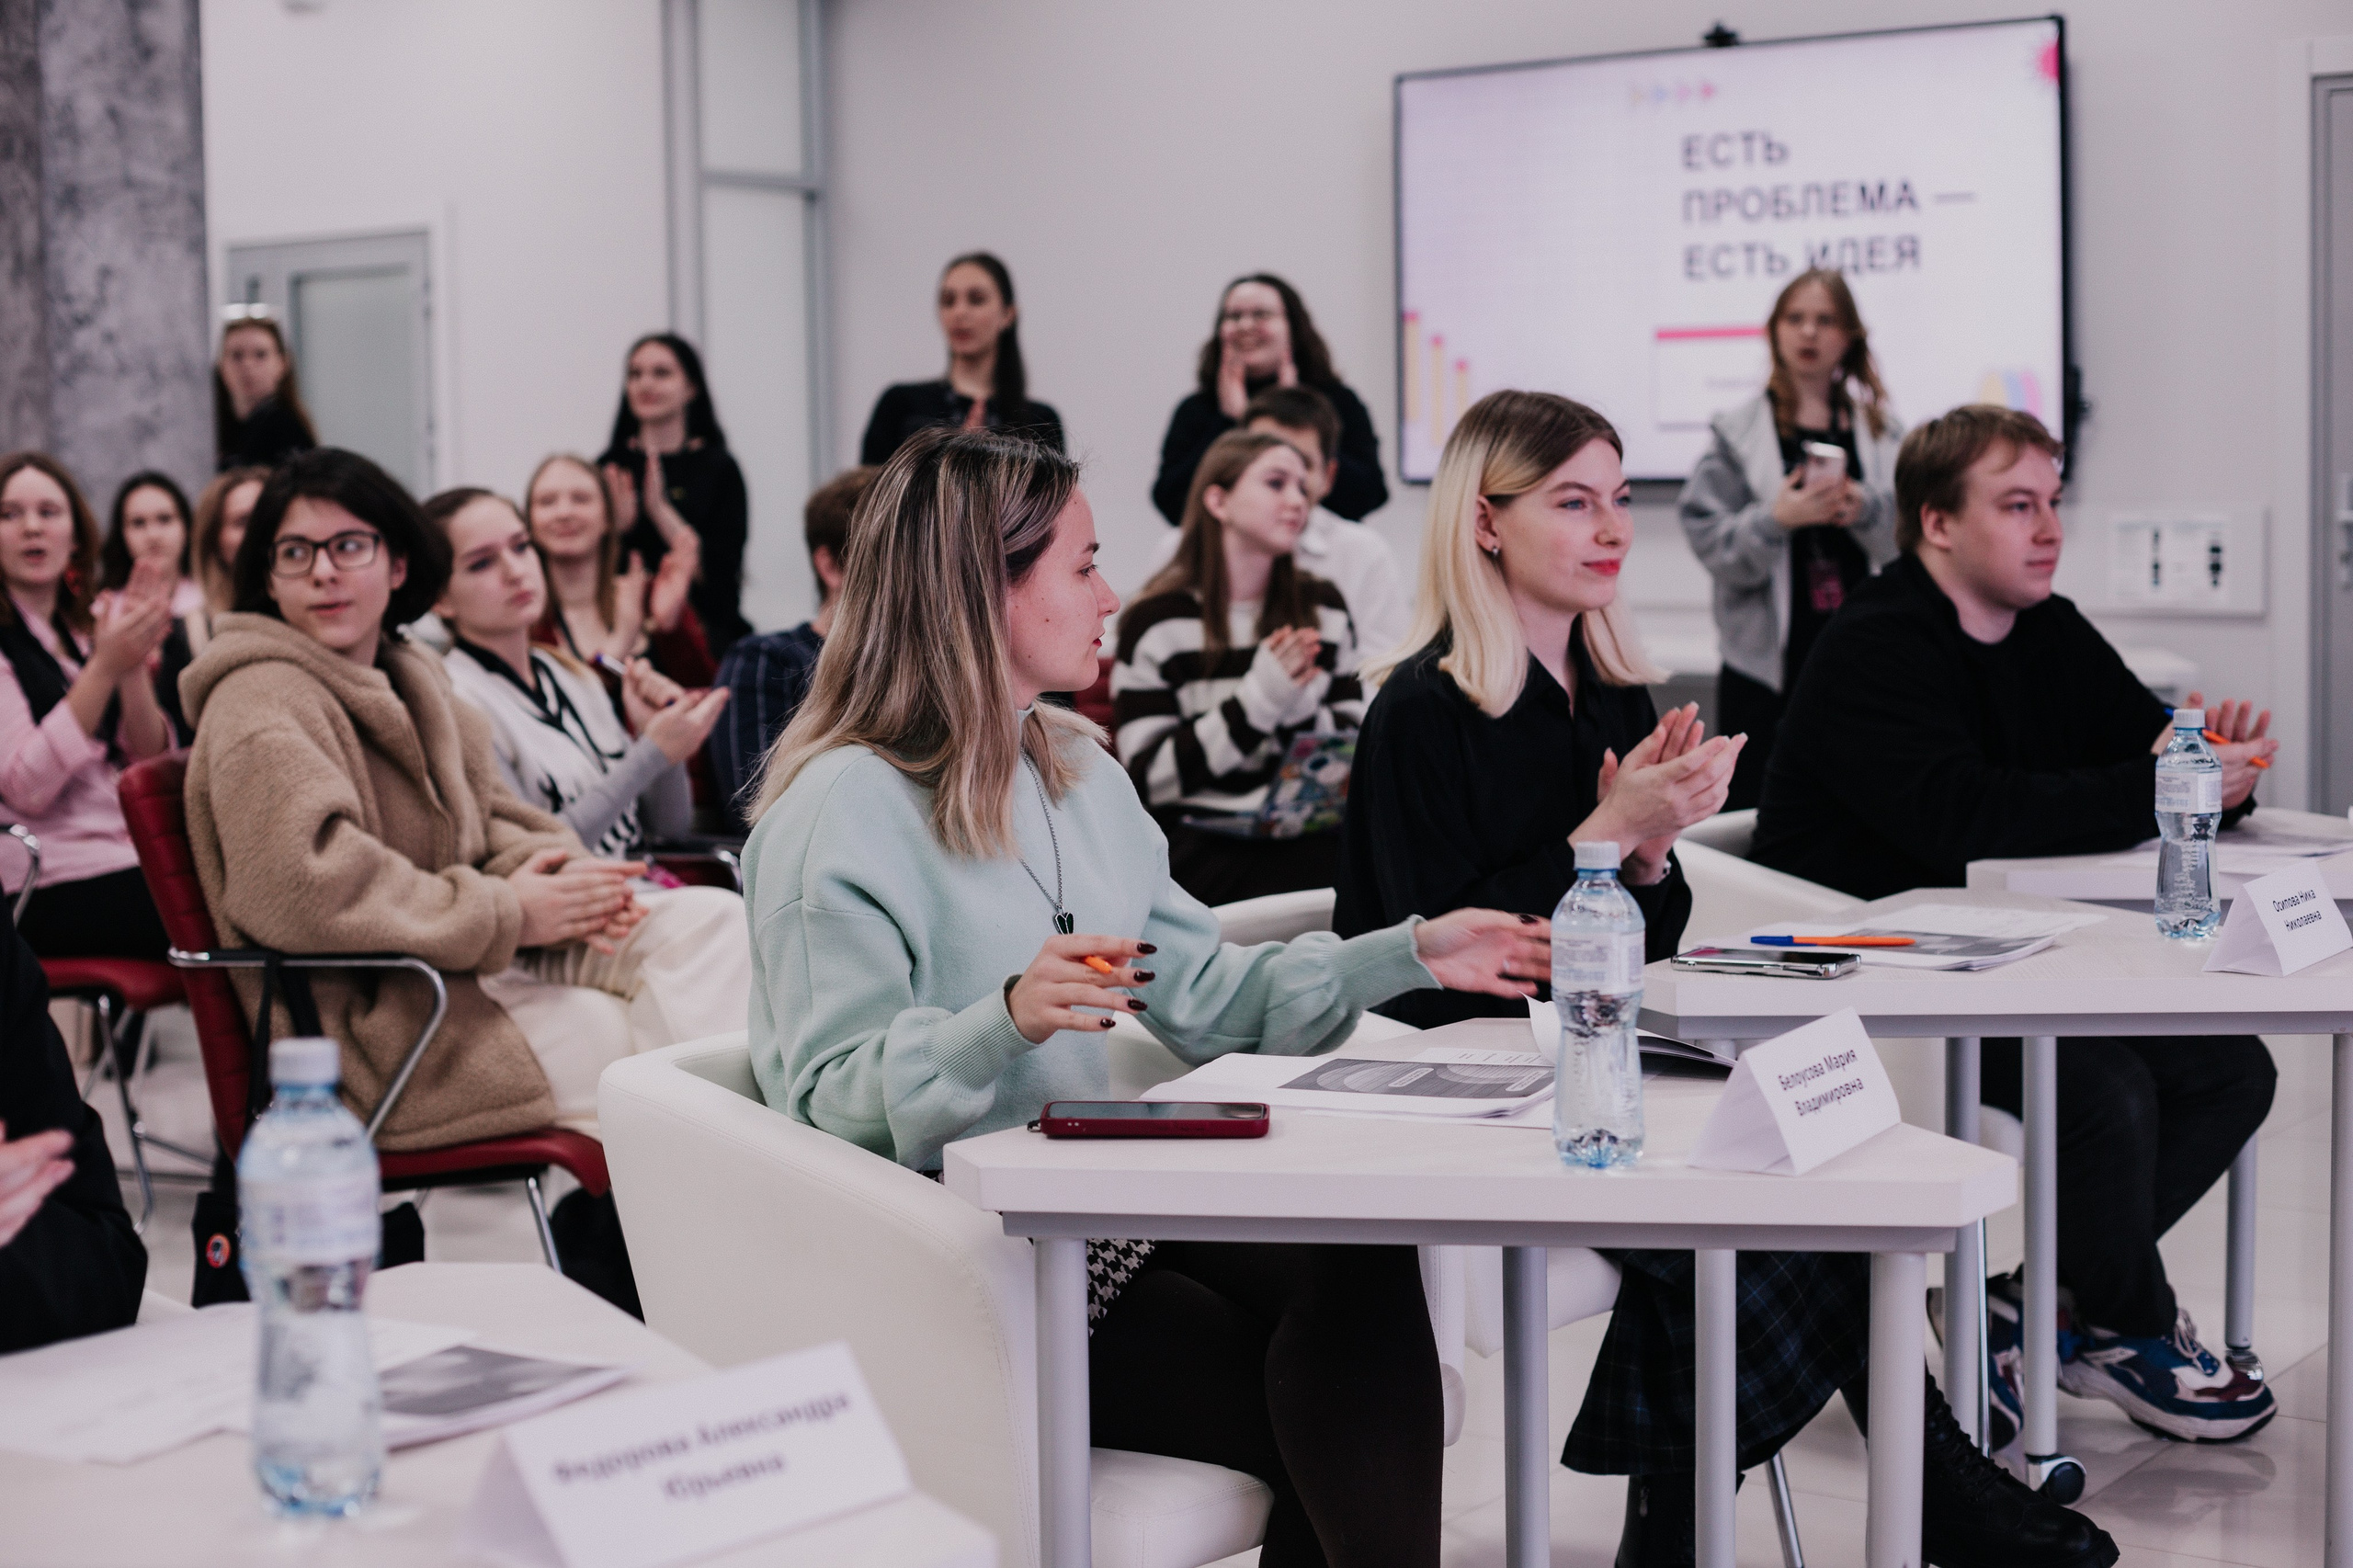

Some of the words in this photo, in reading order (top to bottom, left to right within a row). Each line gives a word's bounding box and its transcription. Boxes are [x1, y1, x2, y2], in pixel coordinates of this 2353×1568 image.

[1681, 130, 1790, 171] ЕСТЬ
[1681, 178, 1920, 223] ПРОБЛЕМА
[1682, 241, 1790, 280] ЕСТЬ
[1804, 233, 1920, 276] ИДЕЯ
[2272, 895, 2300, 912] Осипова
[2298, 890, 2316, 903] Ника
[2284, 910, 2322, 932] Николаевна
[1778, 1062, 1824, 1090] Белоусова
[1824, 1050, 1858, 1072] Мария
[1795, 1078, 1864, 1116] Владимировна
